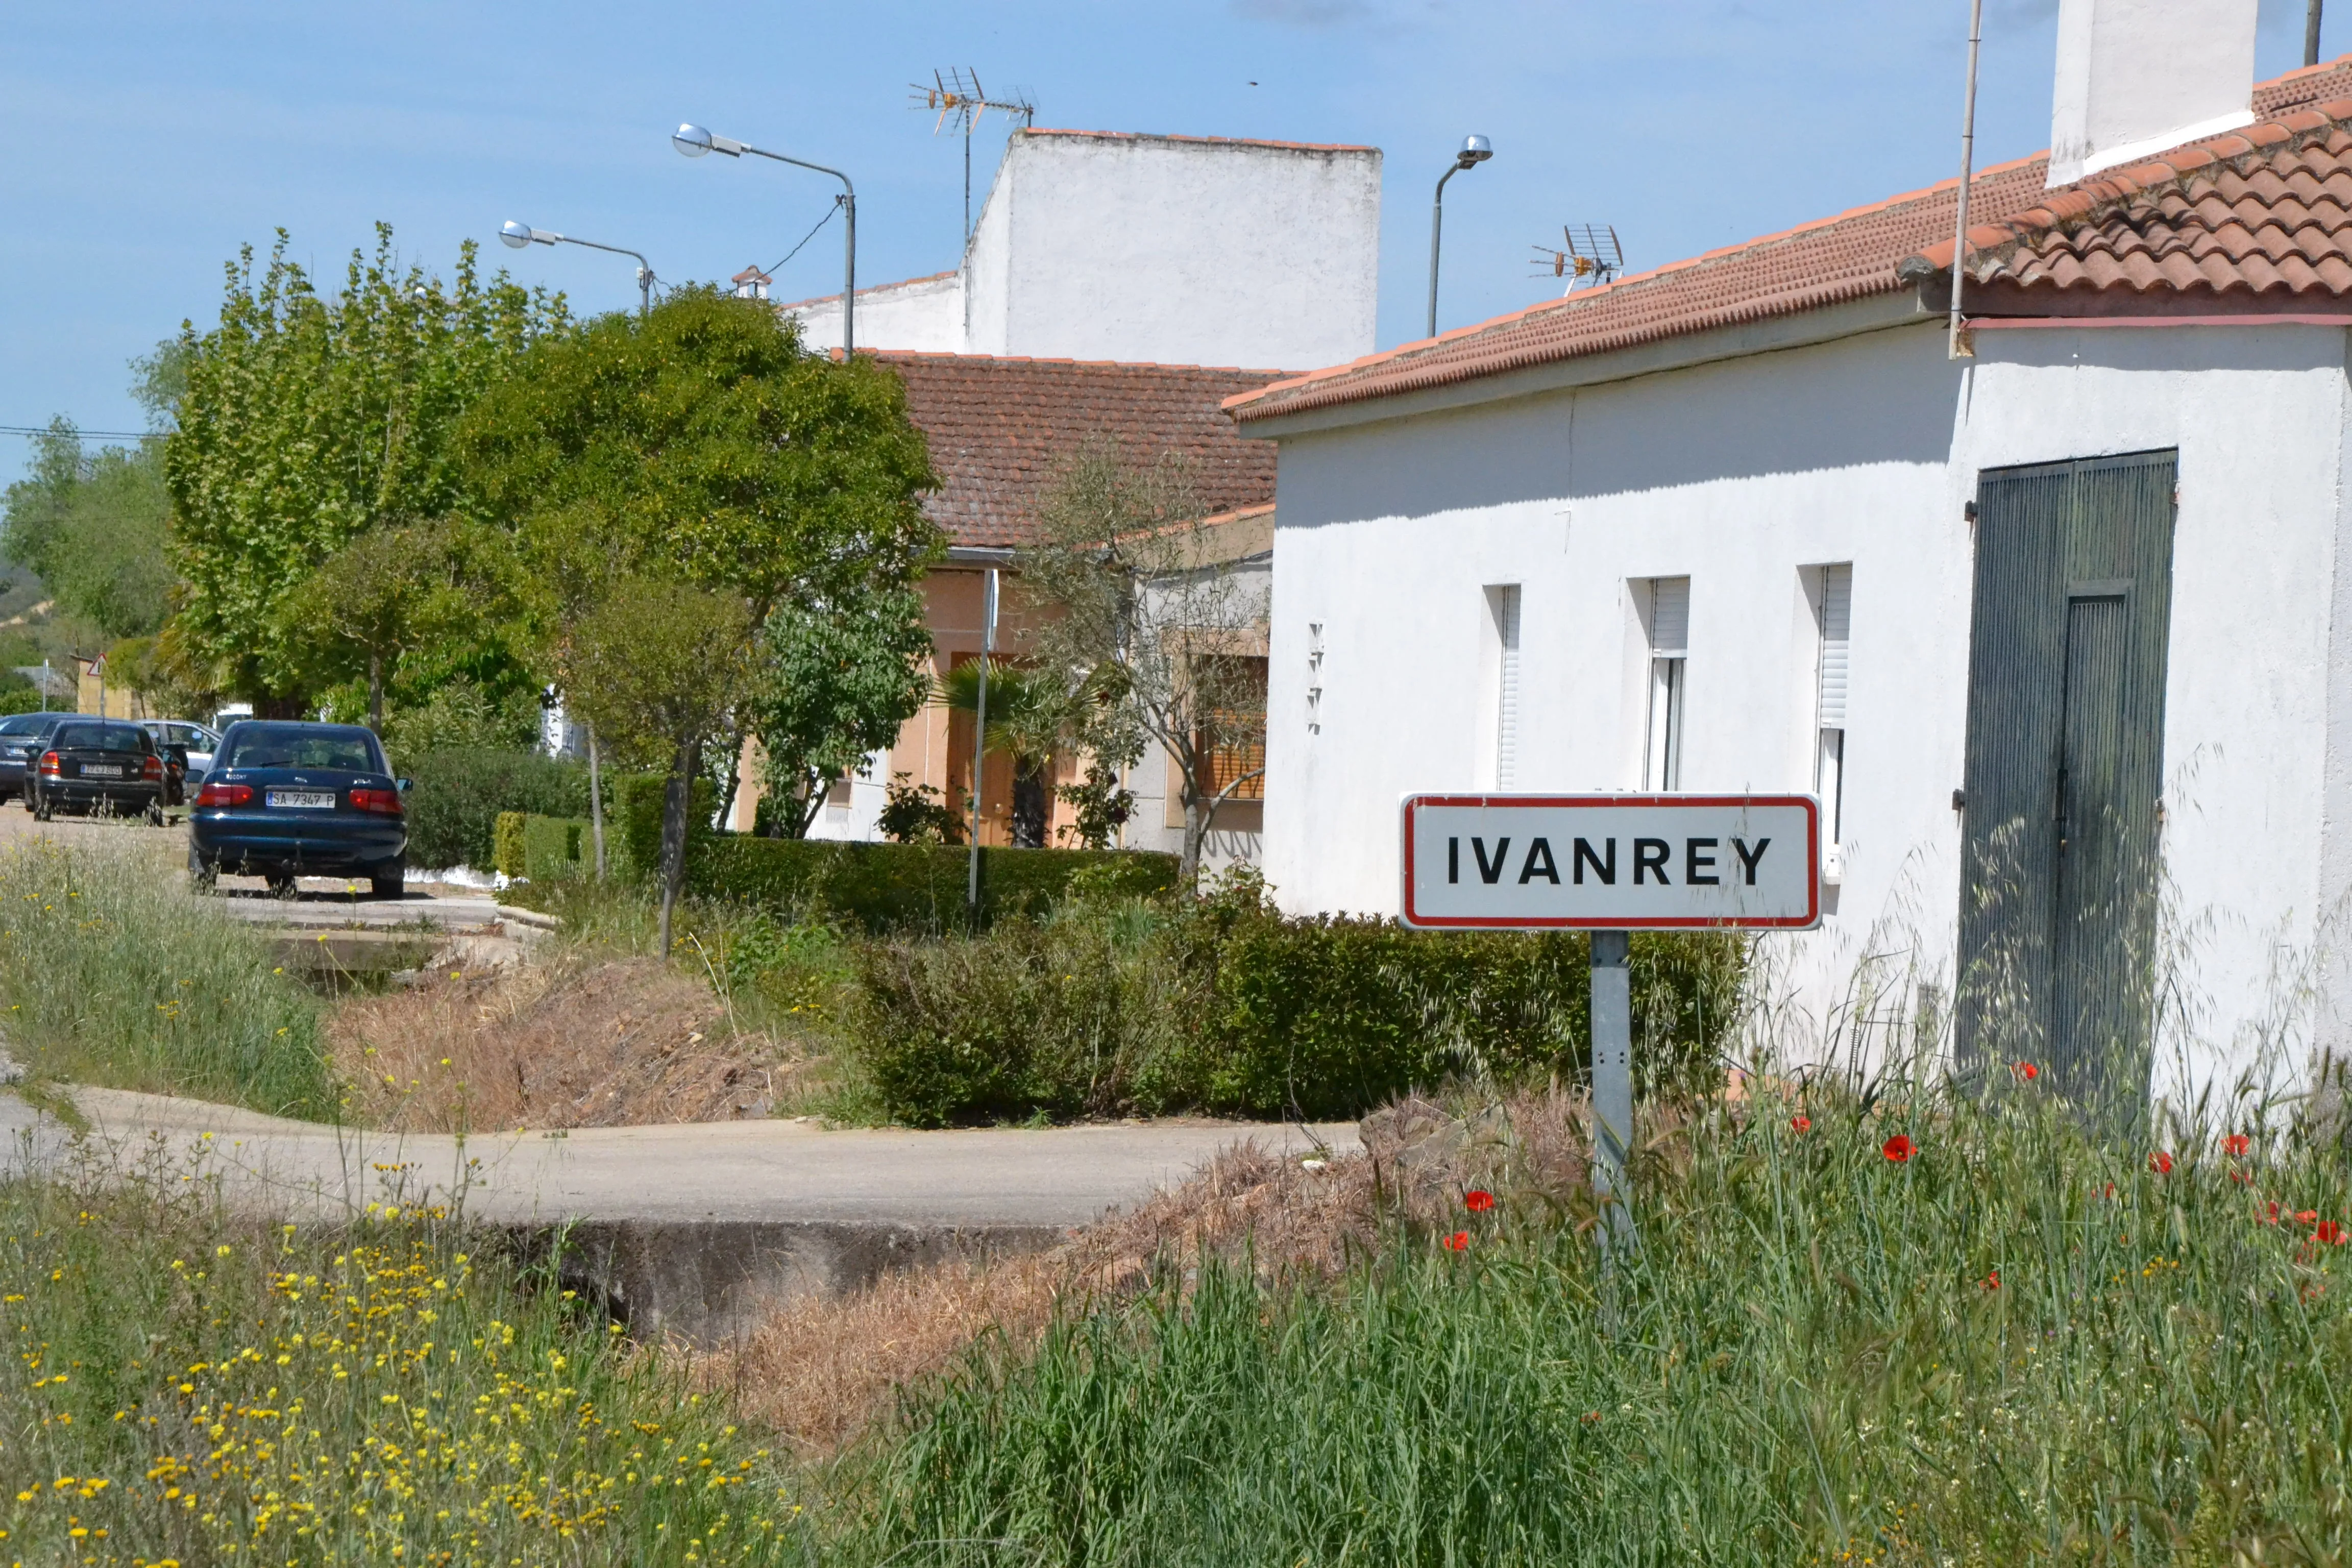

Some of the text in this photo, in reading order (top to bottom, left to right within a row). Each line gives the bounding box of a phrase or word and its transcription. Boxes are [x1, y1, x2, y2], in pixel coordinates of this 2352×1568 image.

[273, 793, 286, 804] SA
[293, 794, 321, 805] 7347
[327, 795, 334, 806] P
[1448, 837, 1771, 885] IVANREY
